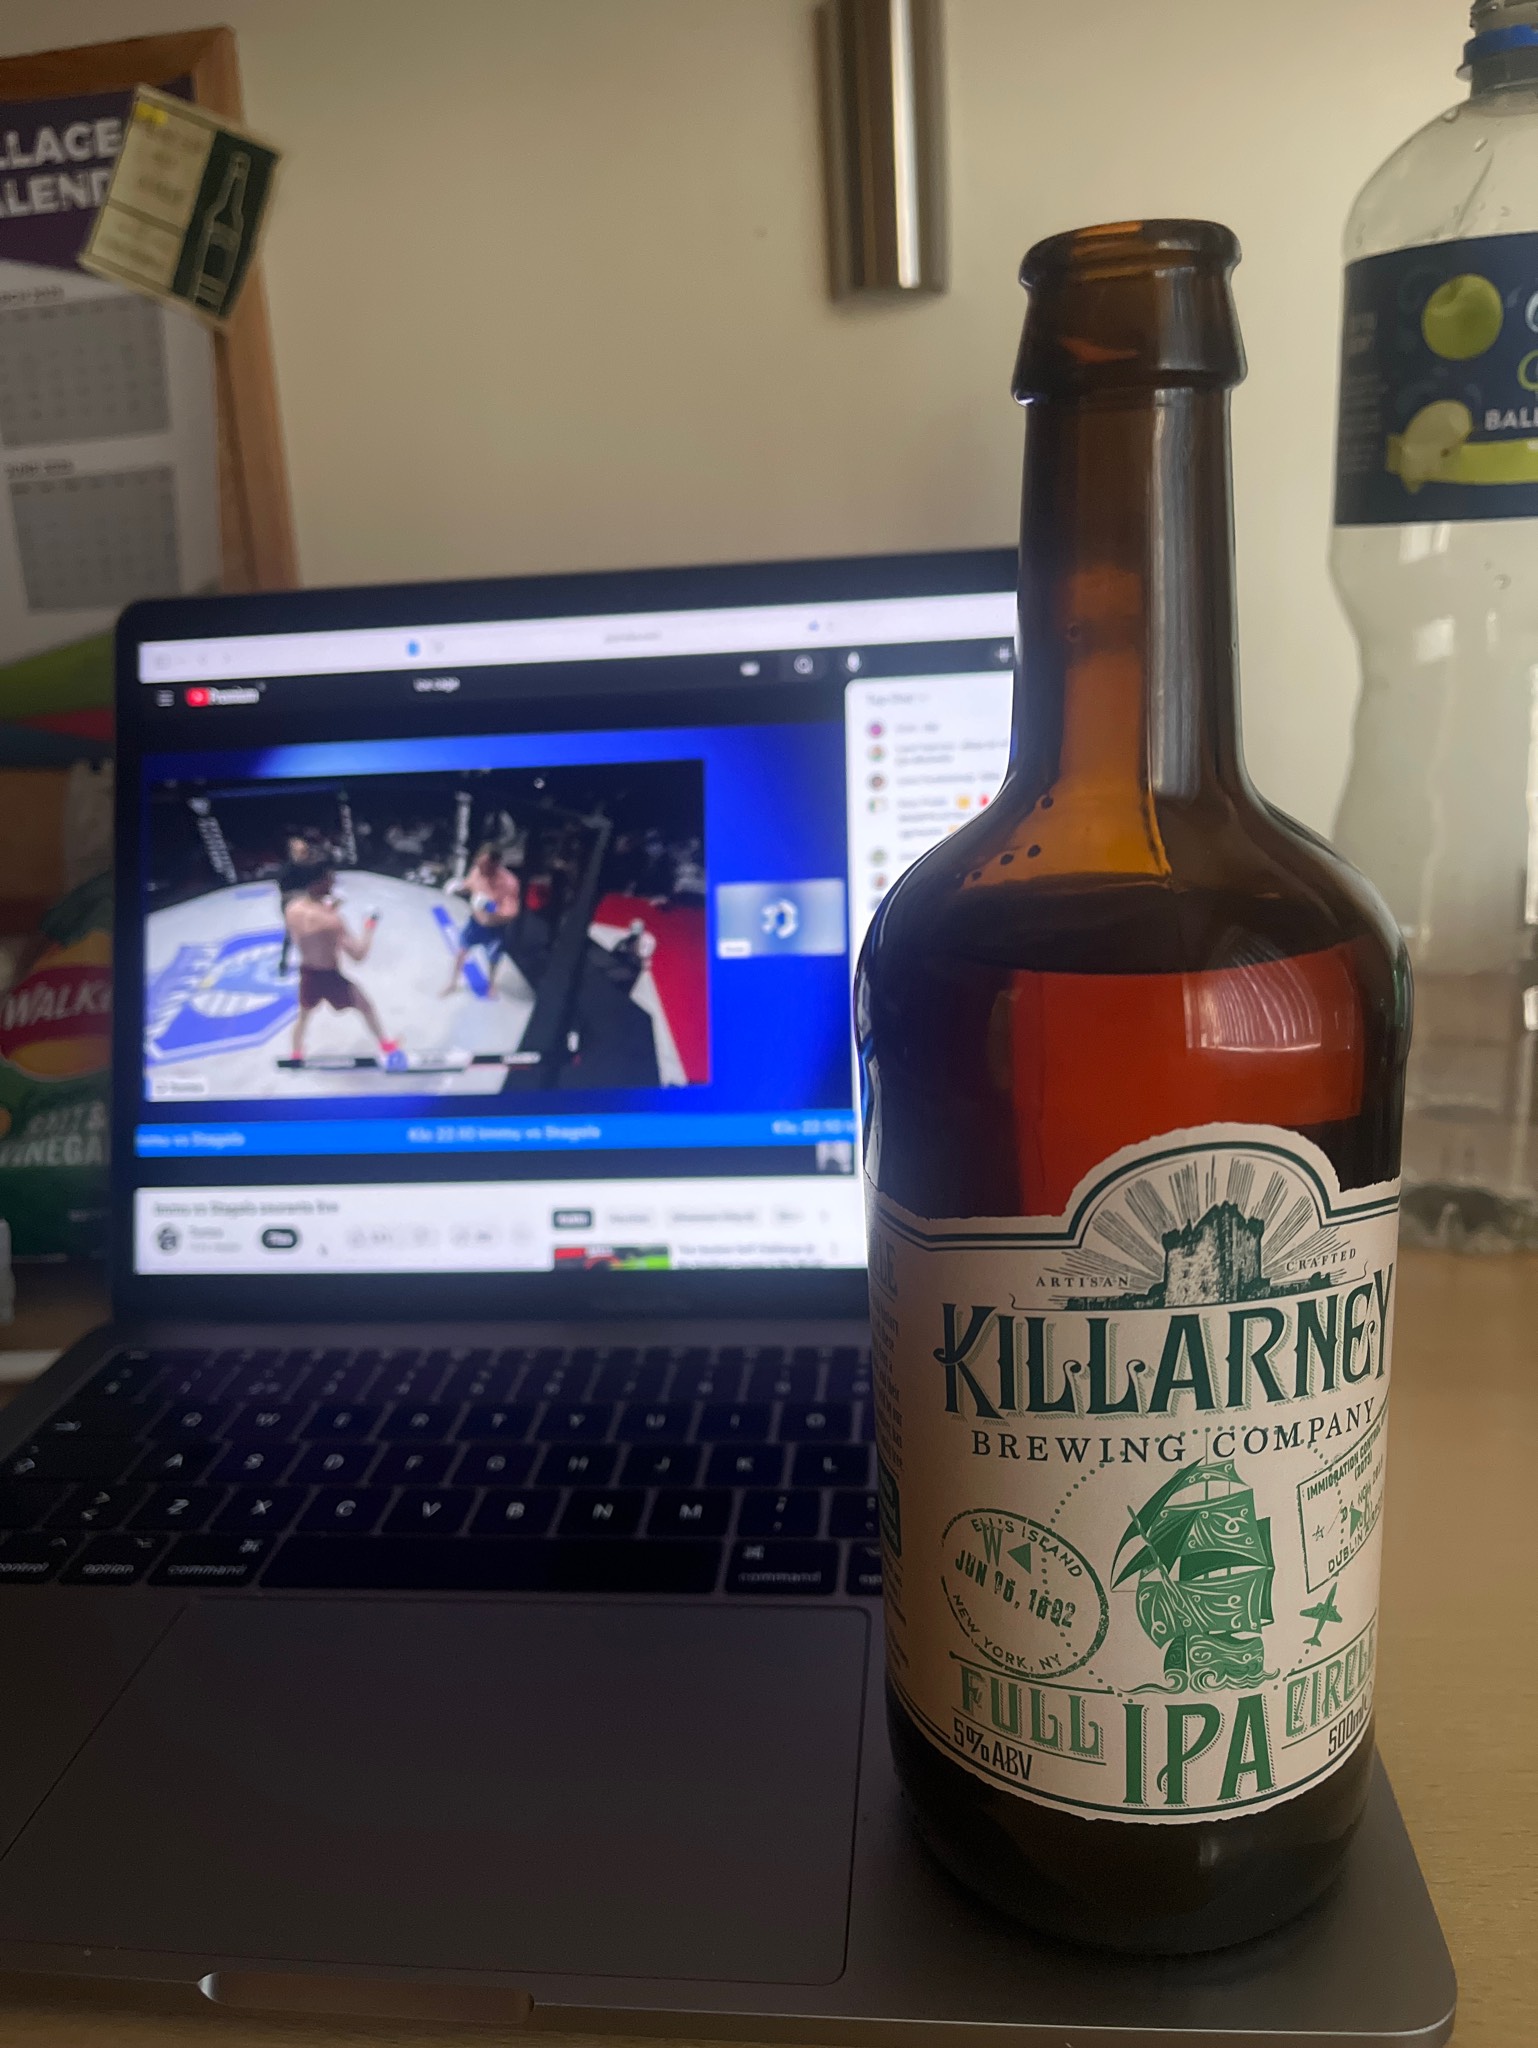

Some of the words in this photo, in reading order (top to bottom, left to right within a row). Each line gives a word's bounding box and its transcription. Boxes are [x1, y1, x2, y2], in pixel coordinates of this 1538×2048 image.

[0, 117, 122, 170] LACE
[1035, 1274, 1130, 1288] ARTISAN
[1285, 1247, 1357, 1273] CRAFTED
[932, 1263, 1394, 1426] KILLARNEY
[971, 1429, 1186, 1463] BREWING
[1211, 1397, 1375, 1459] COMPANY
[0, 1561, 50, 1574] ontrol
[955, 1550, 988, 1588] JUN
[1328, 1532, 1363, 1574] DUBLIN
[952, 1594, 981, 1635] NEW
[1039, 1653, 1063, 1671] NY
[960, 1665, 1104, 1760] FULL
[1121, 1693, 1277, 1807] IPA
